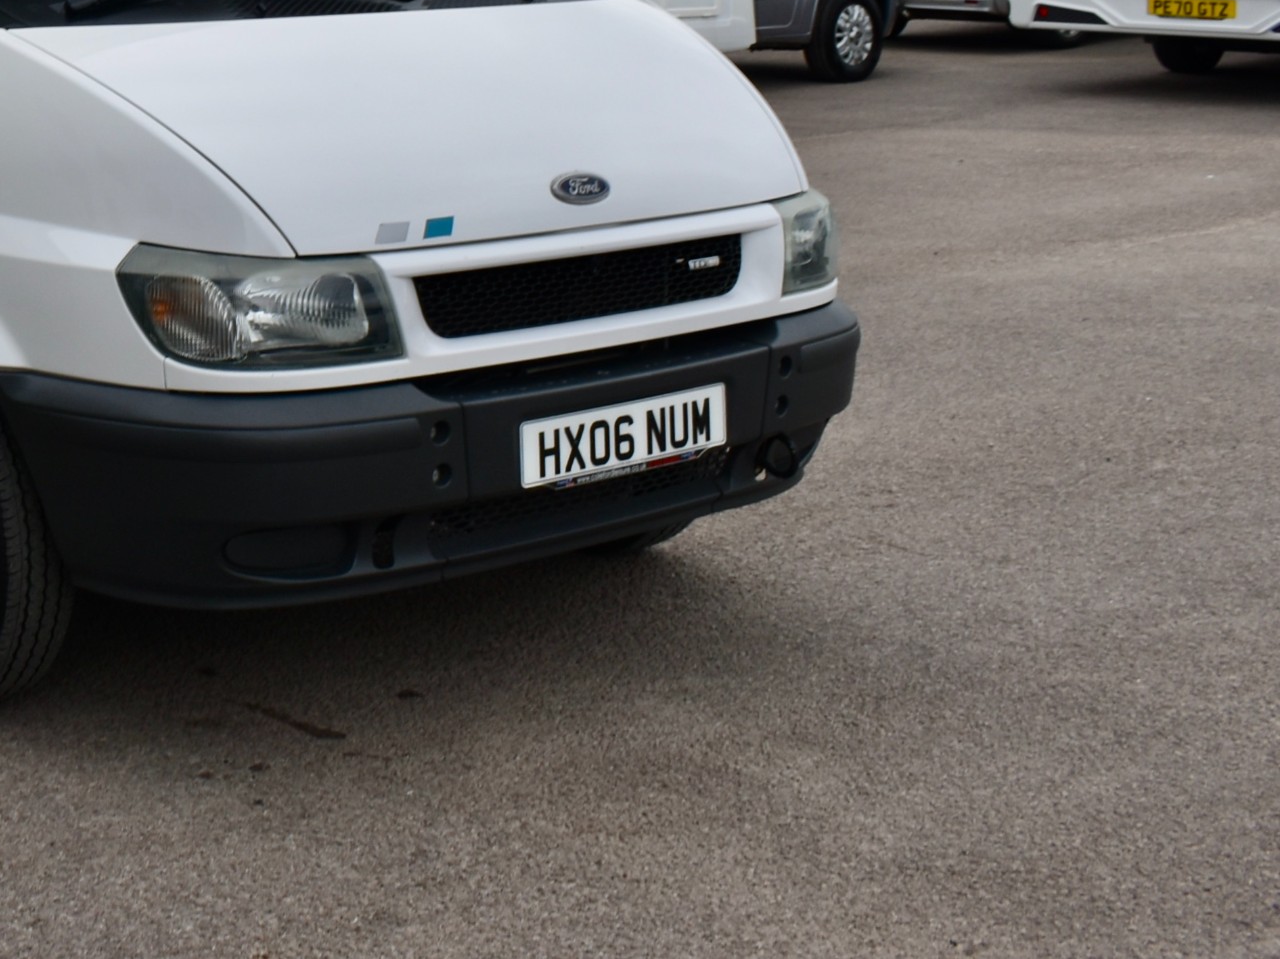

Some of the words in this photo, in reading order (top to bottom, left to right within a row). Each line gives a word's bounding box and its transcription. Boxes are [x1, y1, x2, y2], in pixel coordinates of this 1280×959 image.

[1153, 0, 1193, 15] PE70
[1197, 1, 1229, 17] GTZ
[569, 177, 601, 195] Ford
[538, 414, 635, 479] HX06
[646, 397, 712, 456] NUM
